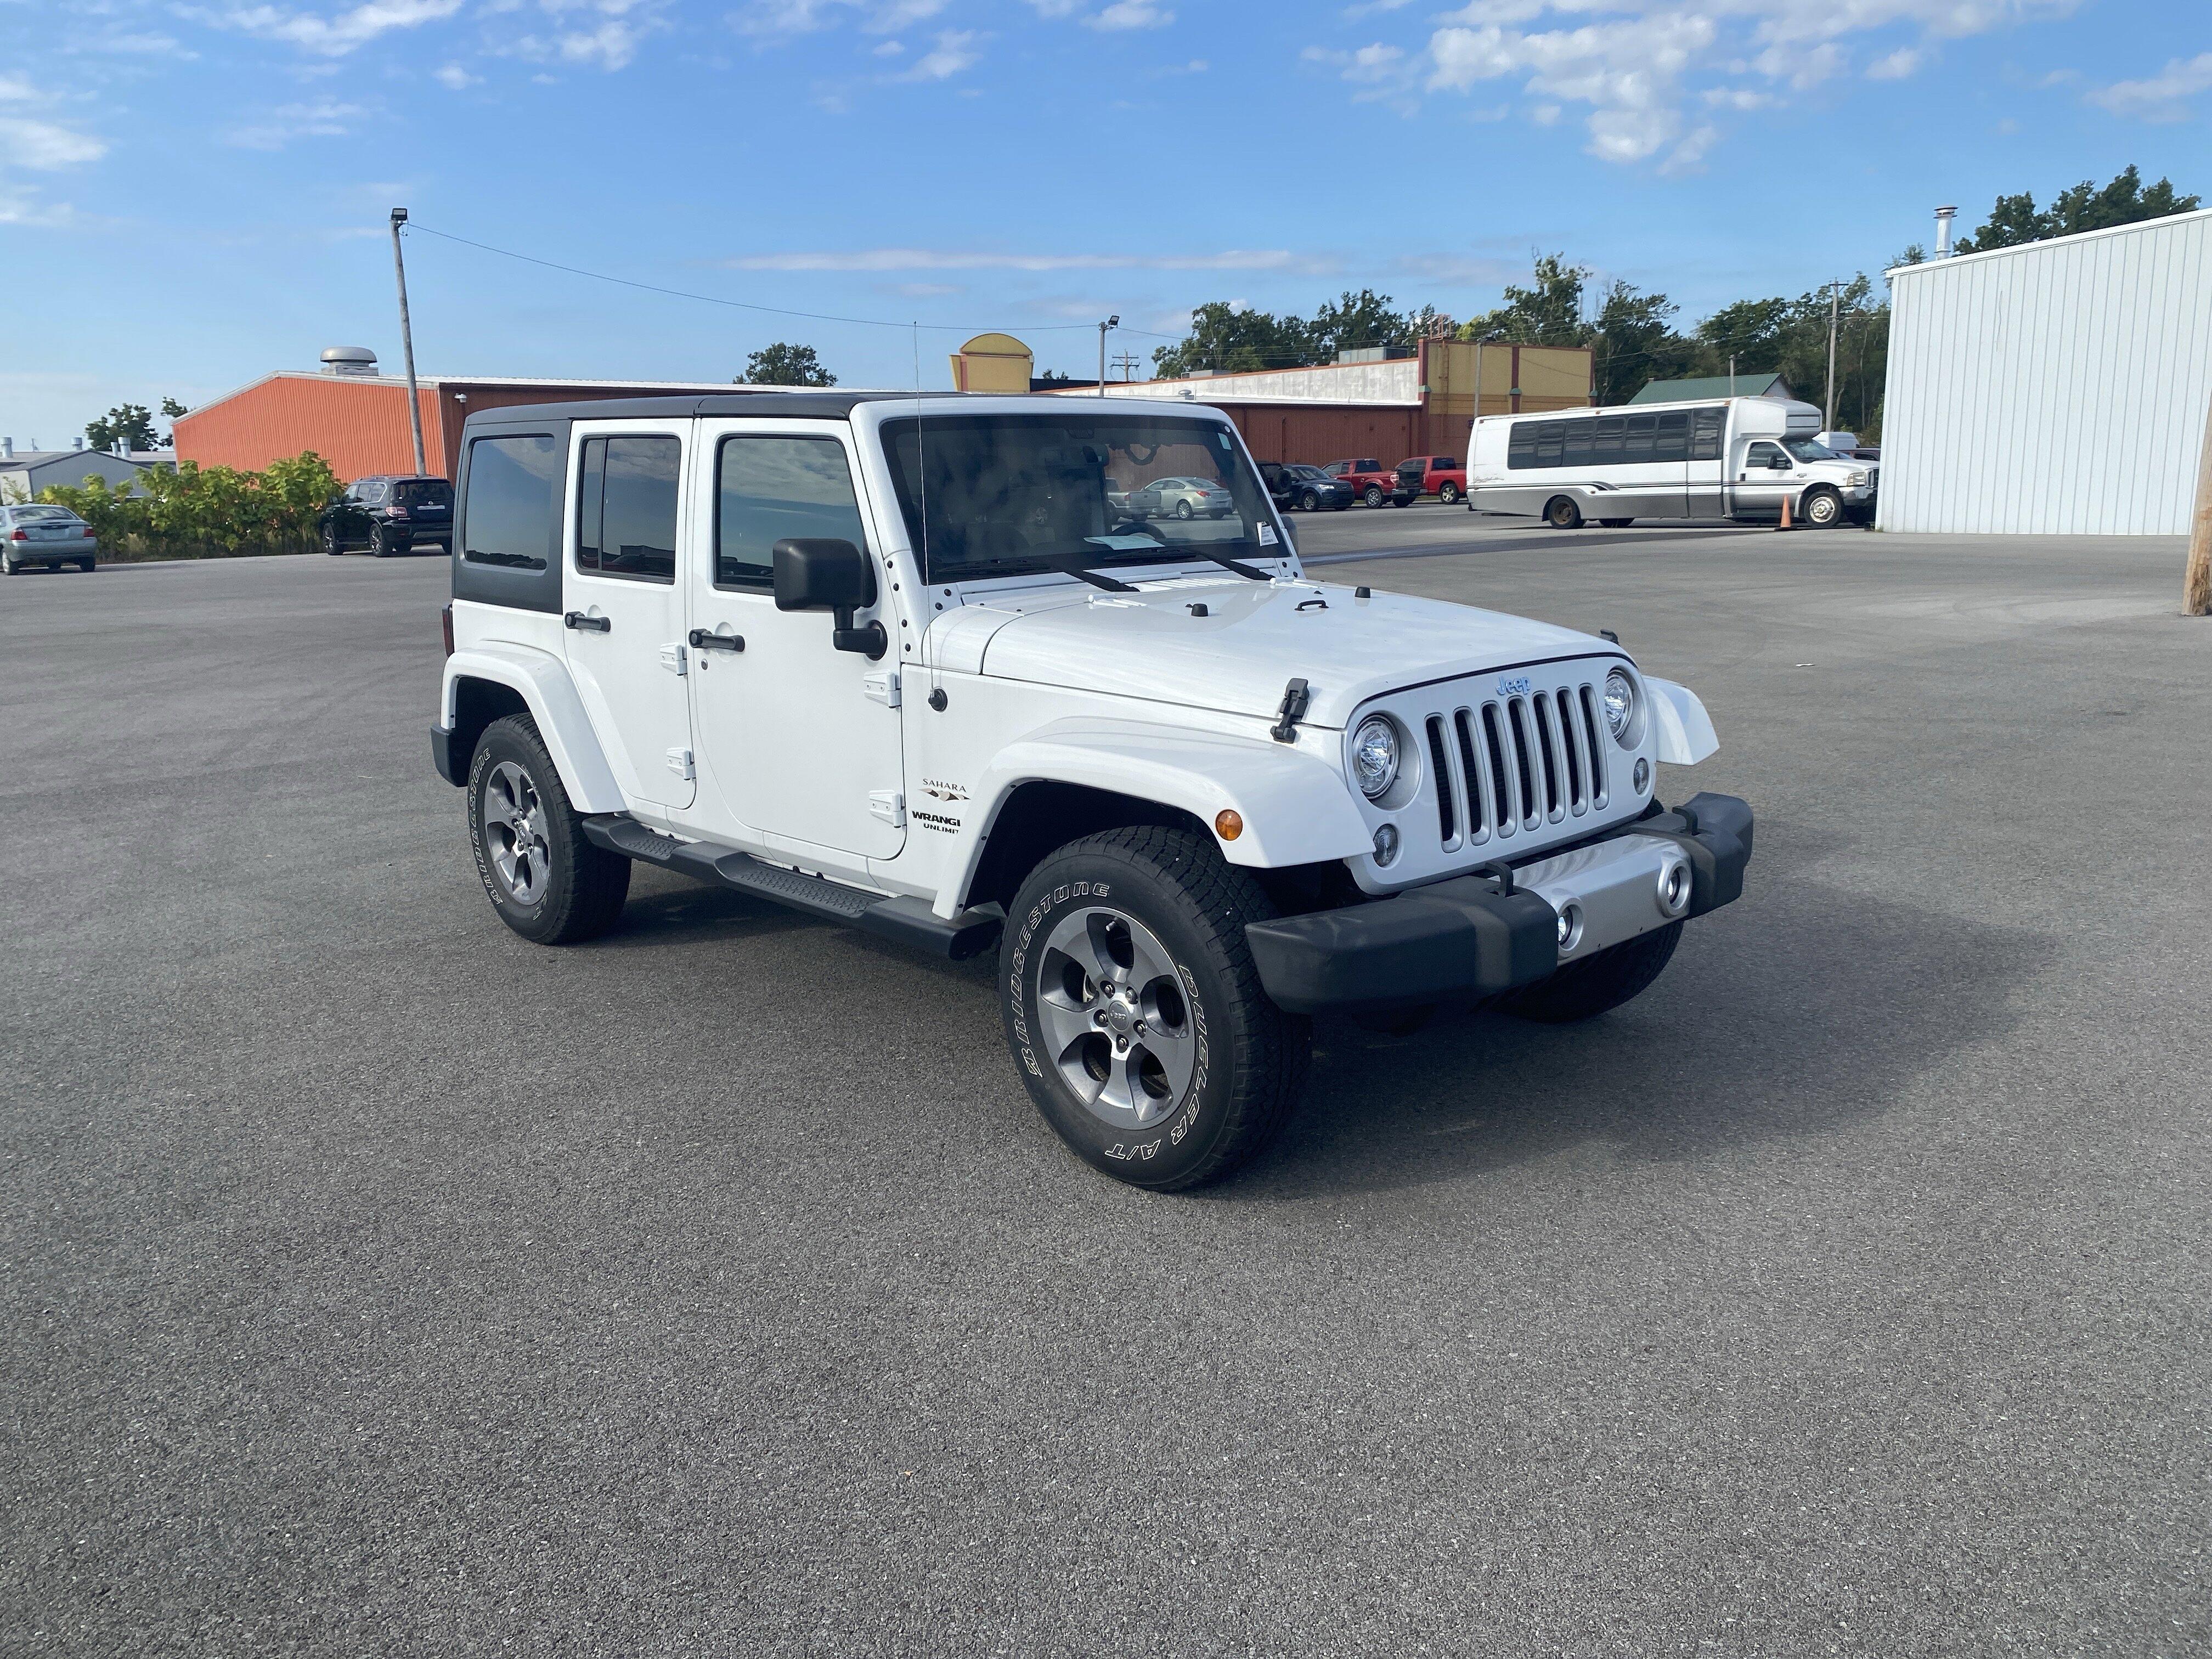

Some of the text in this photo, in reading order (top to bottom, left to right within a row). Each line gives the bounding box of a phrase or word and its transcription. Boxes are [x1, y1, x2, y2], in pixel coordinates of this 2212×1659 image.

[1496, 676, 1531, 696] Jeep
[923, 778, 967, 792] SAHARA
[1009, 881, 1110, 1077] BRIDGESTONE
[1105, 964, 1209, 1161] DUELER A/T
